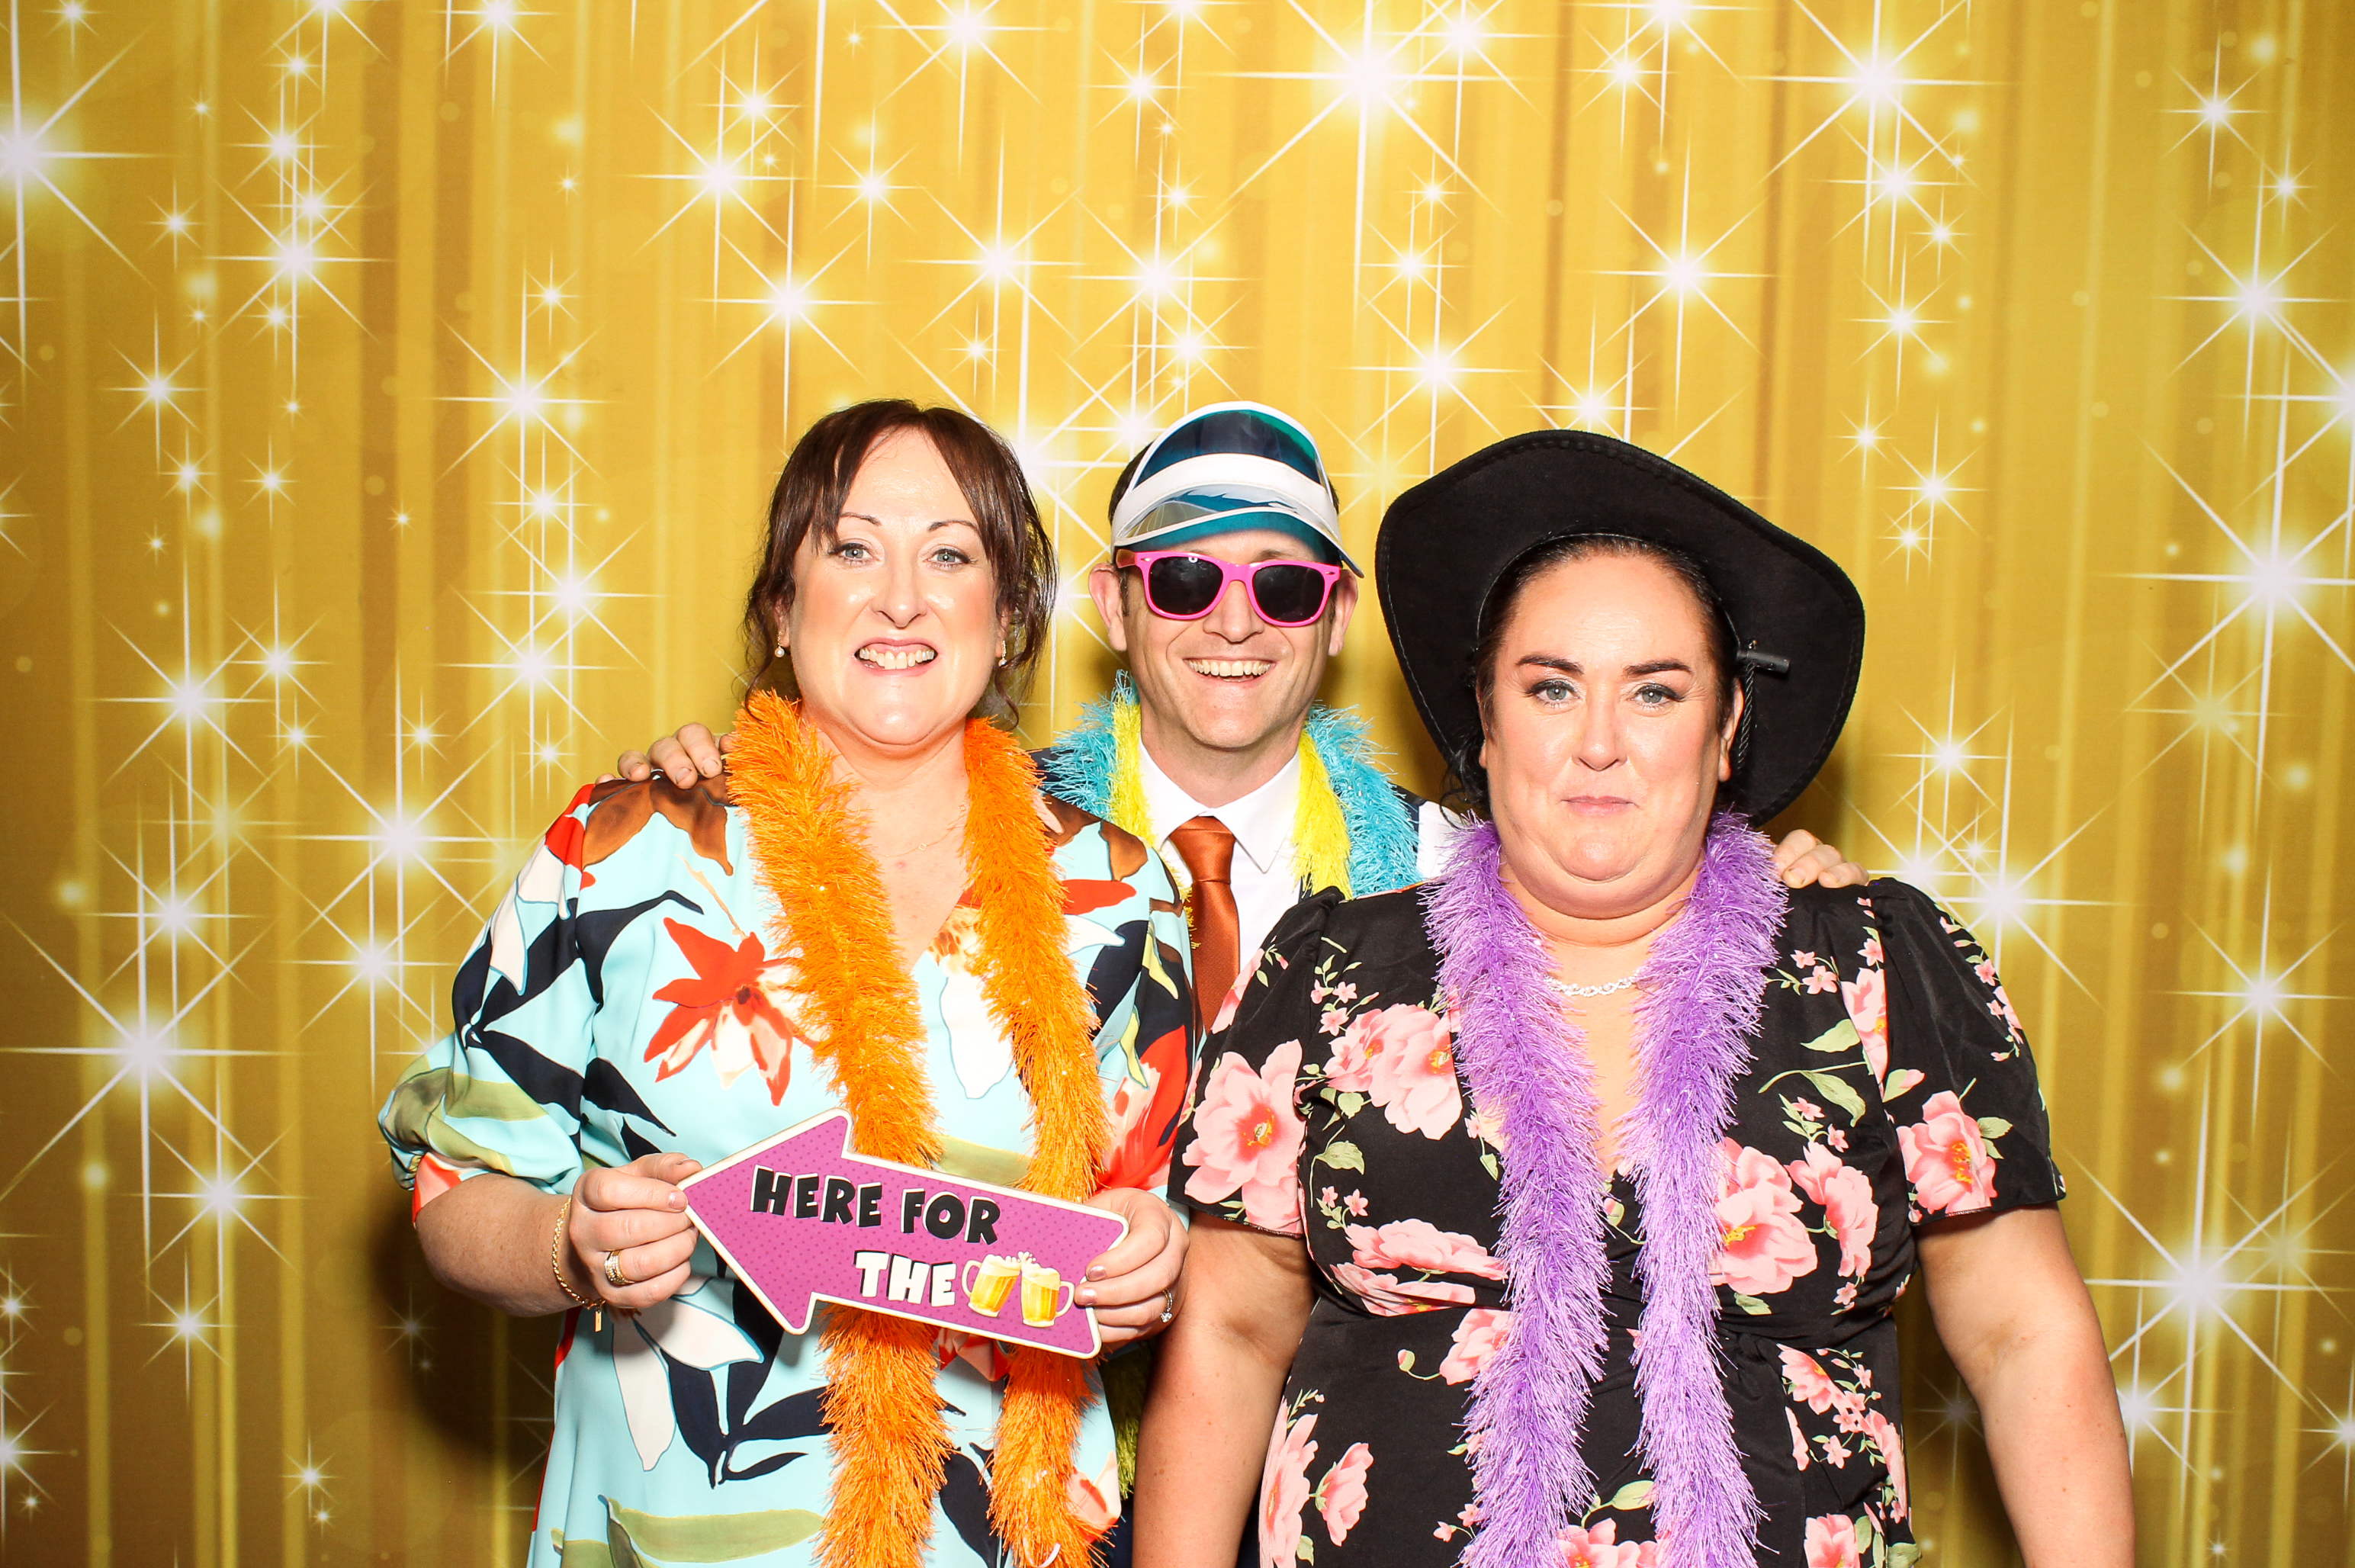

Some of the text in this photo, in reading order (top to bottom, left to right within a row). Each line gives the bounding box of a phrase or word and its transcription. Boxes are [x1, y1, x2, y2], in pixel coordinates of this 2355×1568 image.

[750, 1165, 1001, 1245] HERE FOR
[854, 1249, 957, 1307] THE
